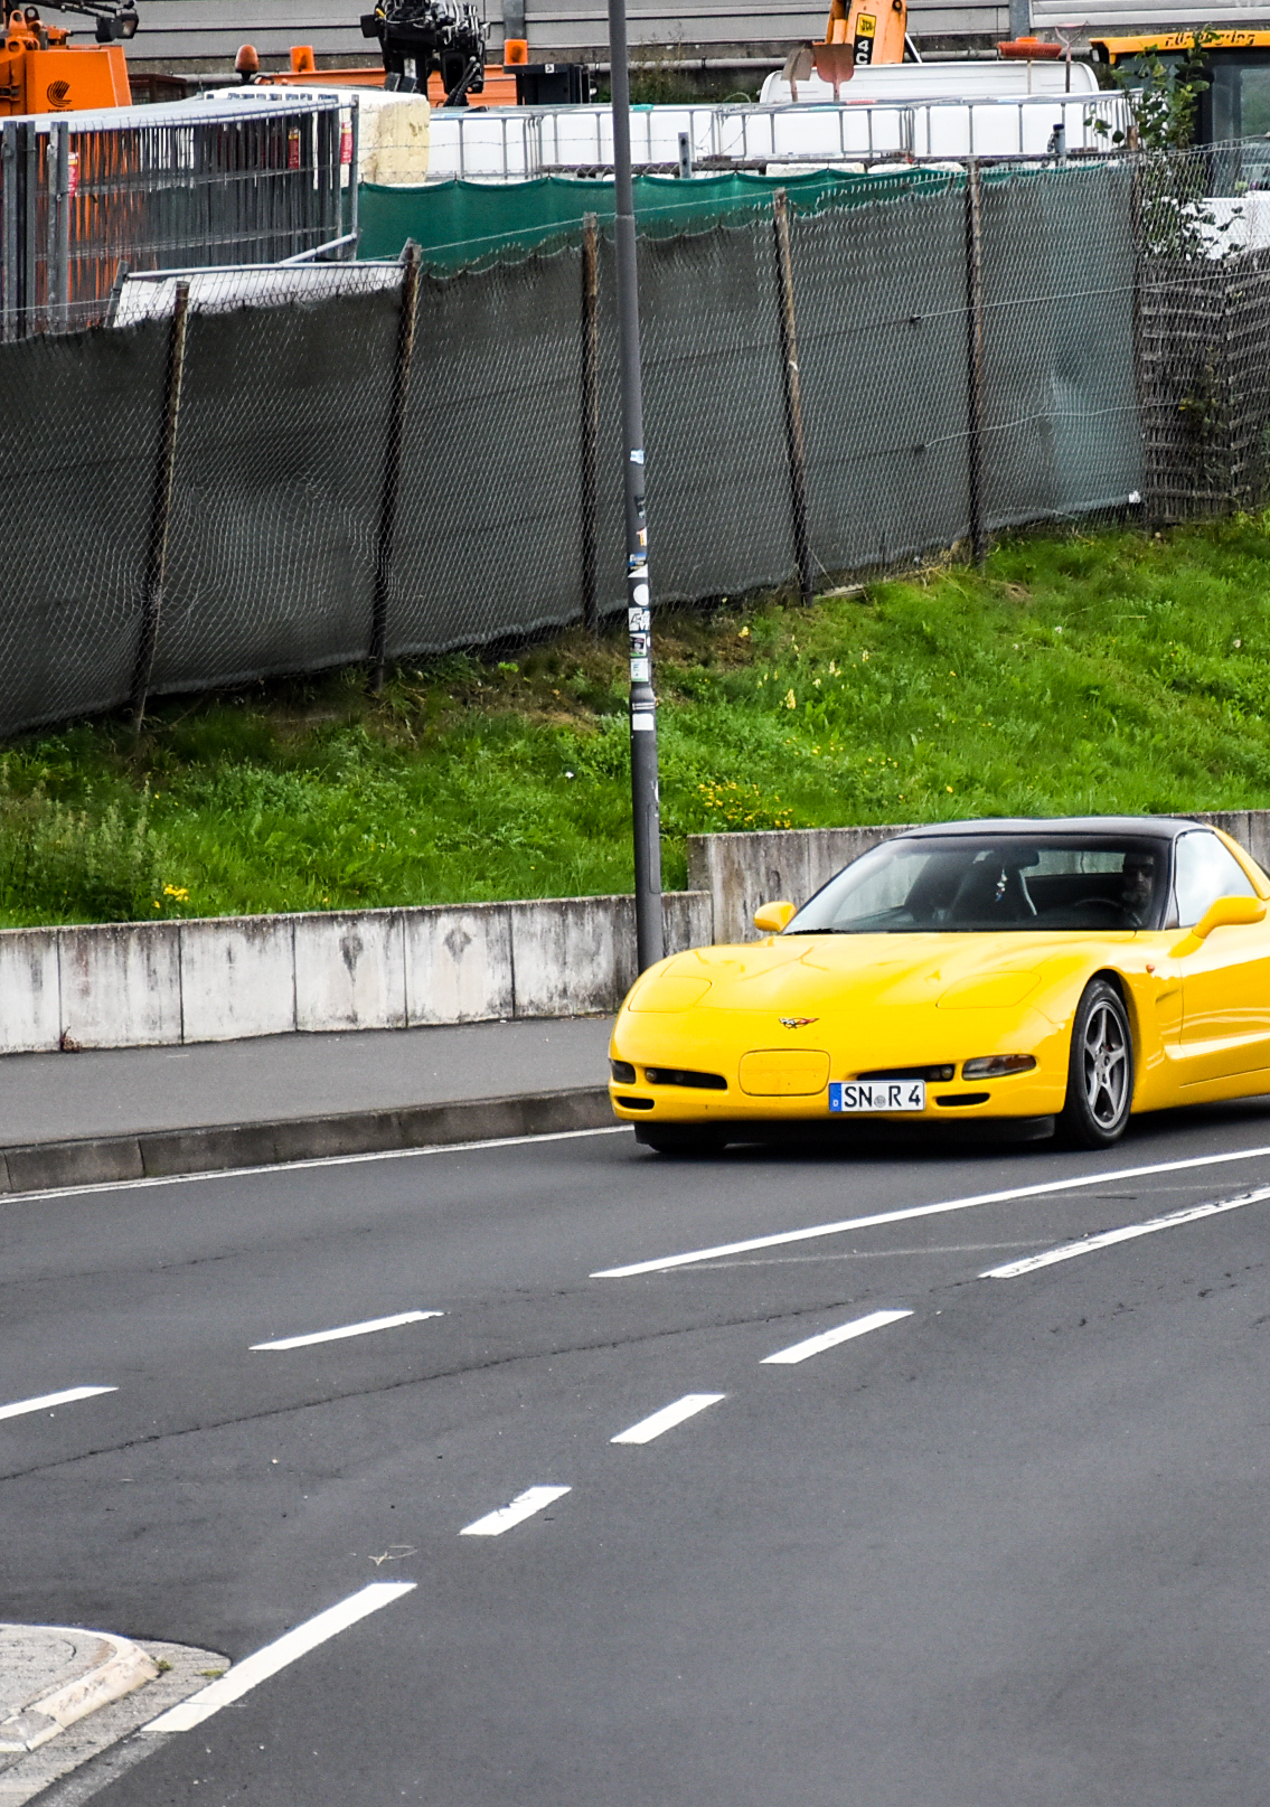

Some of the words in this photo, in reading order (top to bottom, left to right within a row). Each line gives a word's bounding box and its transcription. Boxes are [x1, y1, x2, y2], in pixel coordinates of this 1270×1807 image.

[844, 1086, 873, 1108] SN
[888, 1085, 902, 1107] R
[908, 1085, 921, 1107] 4
